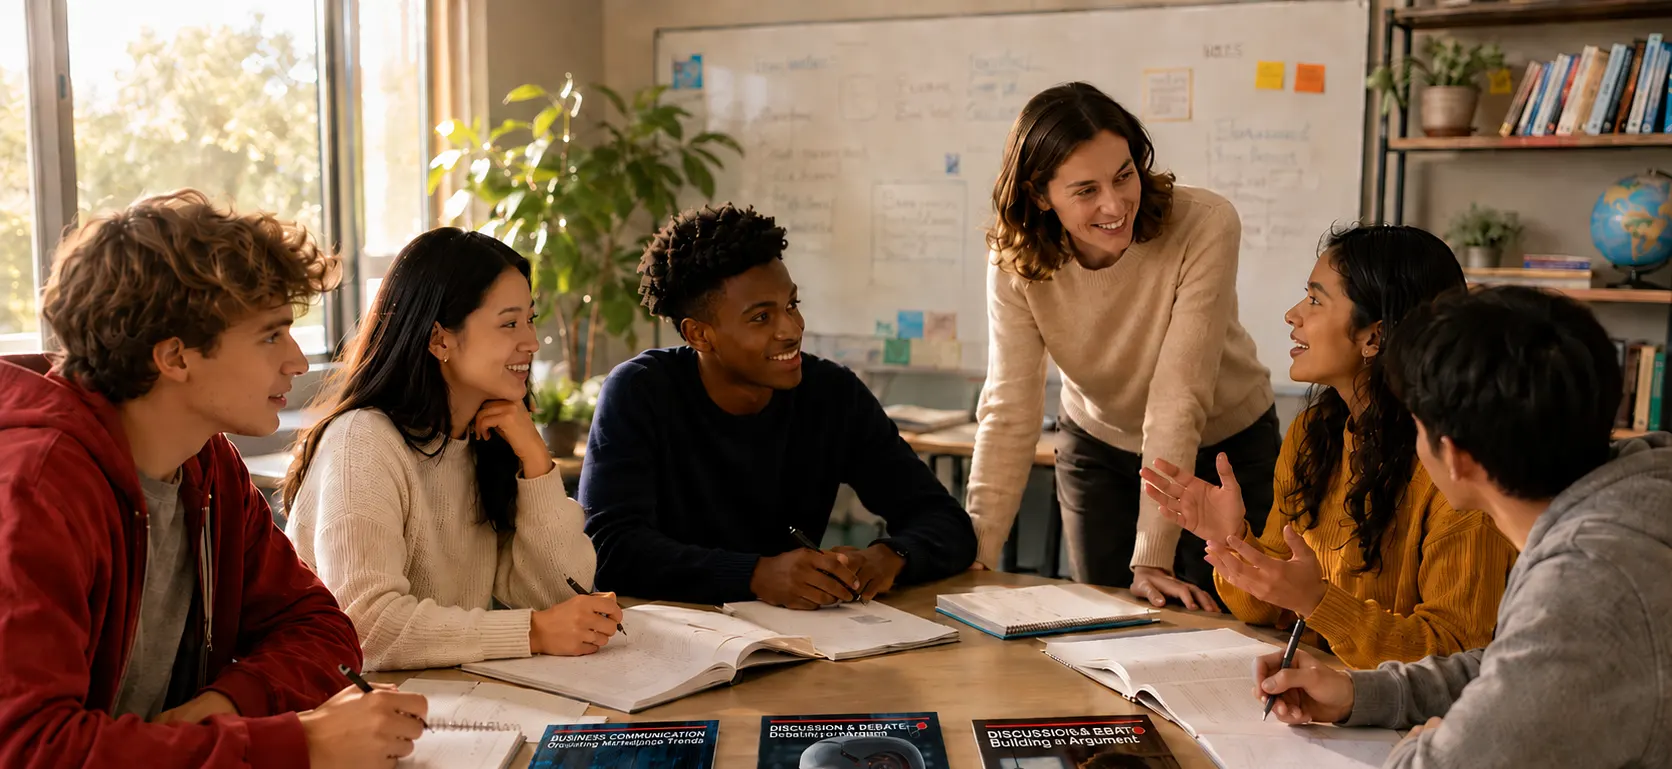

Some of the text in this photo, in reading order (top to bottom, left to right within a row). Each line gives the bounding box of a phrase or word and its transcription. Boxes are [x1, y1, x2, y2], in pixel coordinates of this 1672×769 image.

[859, 722, 907, 731] DEBATE
[550, 730, 705, 742] BUSINESS COMMUNICATION
[990, 738, 1052, 749] Building
[1069, 735, 1141, 748] Argument
